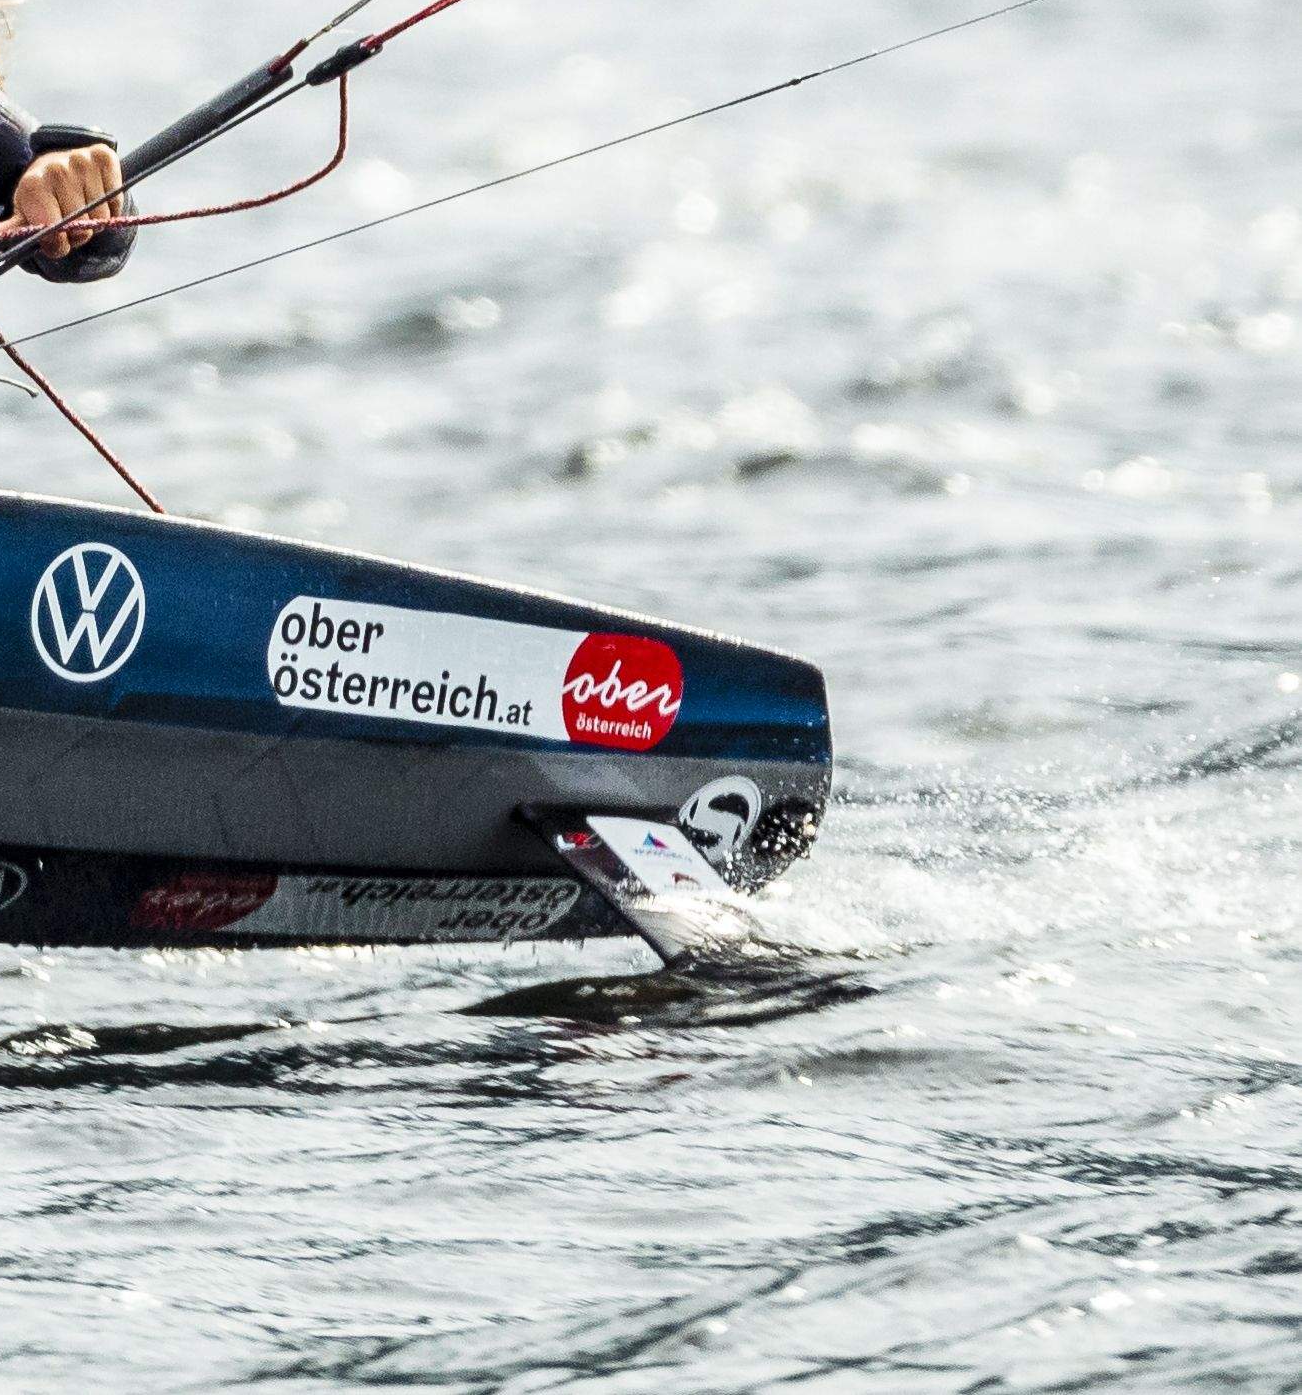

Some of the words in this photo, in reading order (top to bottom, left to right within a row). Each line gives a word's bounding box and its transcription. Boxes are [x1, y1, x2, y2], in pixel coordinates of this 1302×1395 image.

[280, 602, 385, 655] ober
[273, 653, 533, 727] österreich.at
[561, 659, 681, 717] ober
[576, 711, 653, 740] österreich
